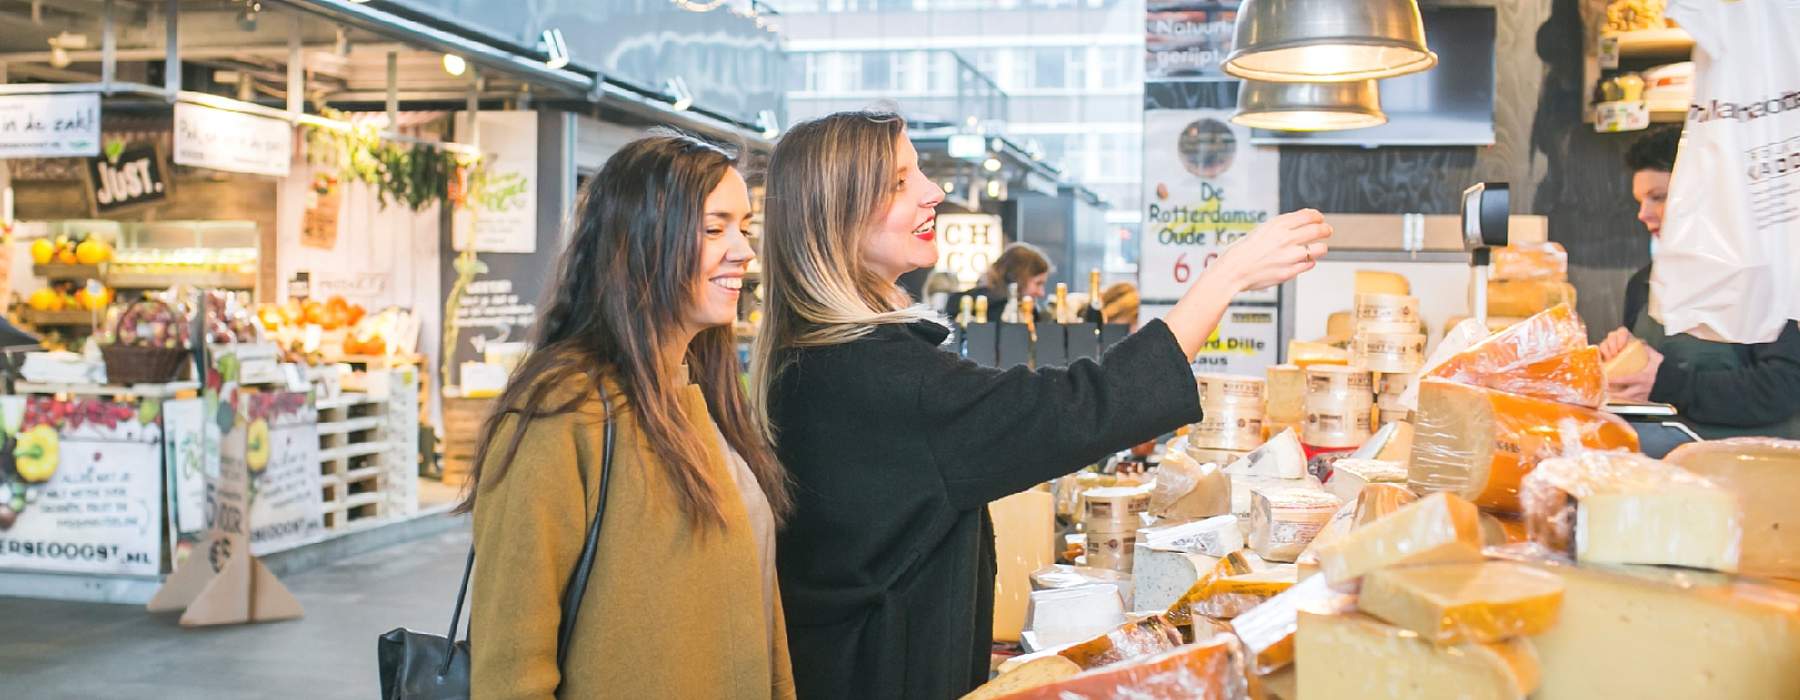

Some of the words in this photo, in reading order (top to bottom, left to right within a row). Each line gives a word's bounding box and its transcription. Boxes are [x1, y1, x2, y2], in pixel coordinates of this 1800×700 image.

[97, 158, 163, 206] JUST.
[1201, 182, 1225, 202] De
[1149, 204, 1268, 224] Rotterdamse
[945, 223, 991, 245] CH
[1158, 226, 1206, 246] Oude
[1174, 253, 1191, 284] 6
[1227, 336, 1266, 351] Dille
[1193, 356, 1229, 366] aus
